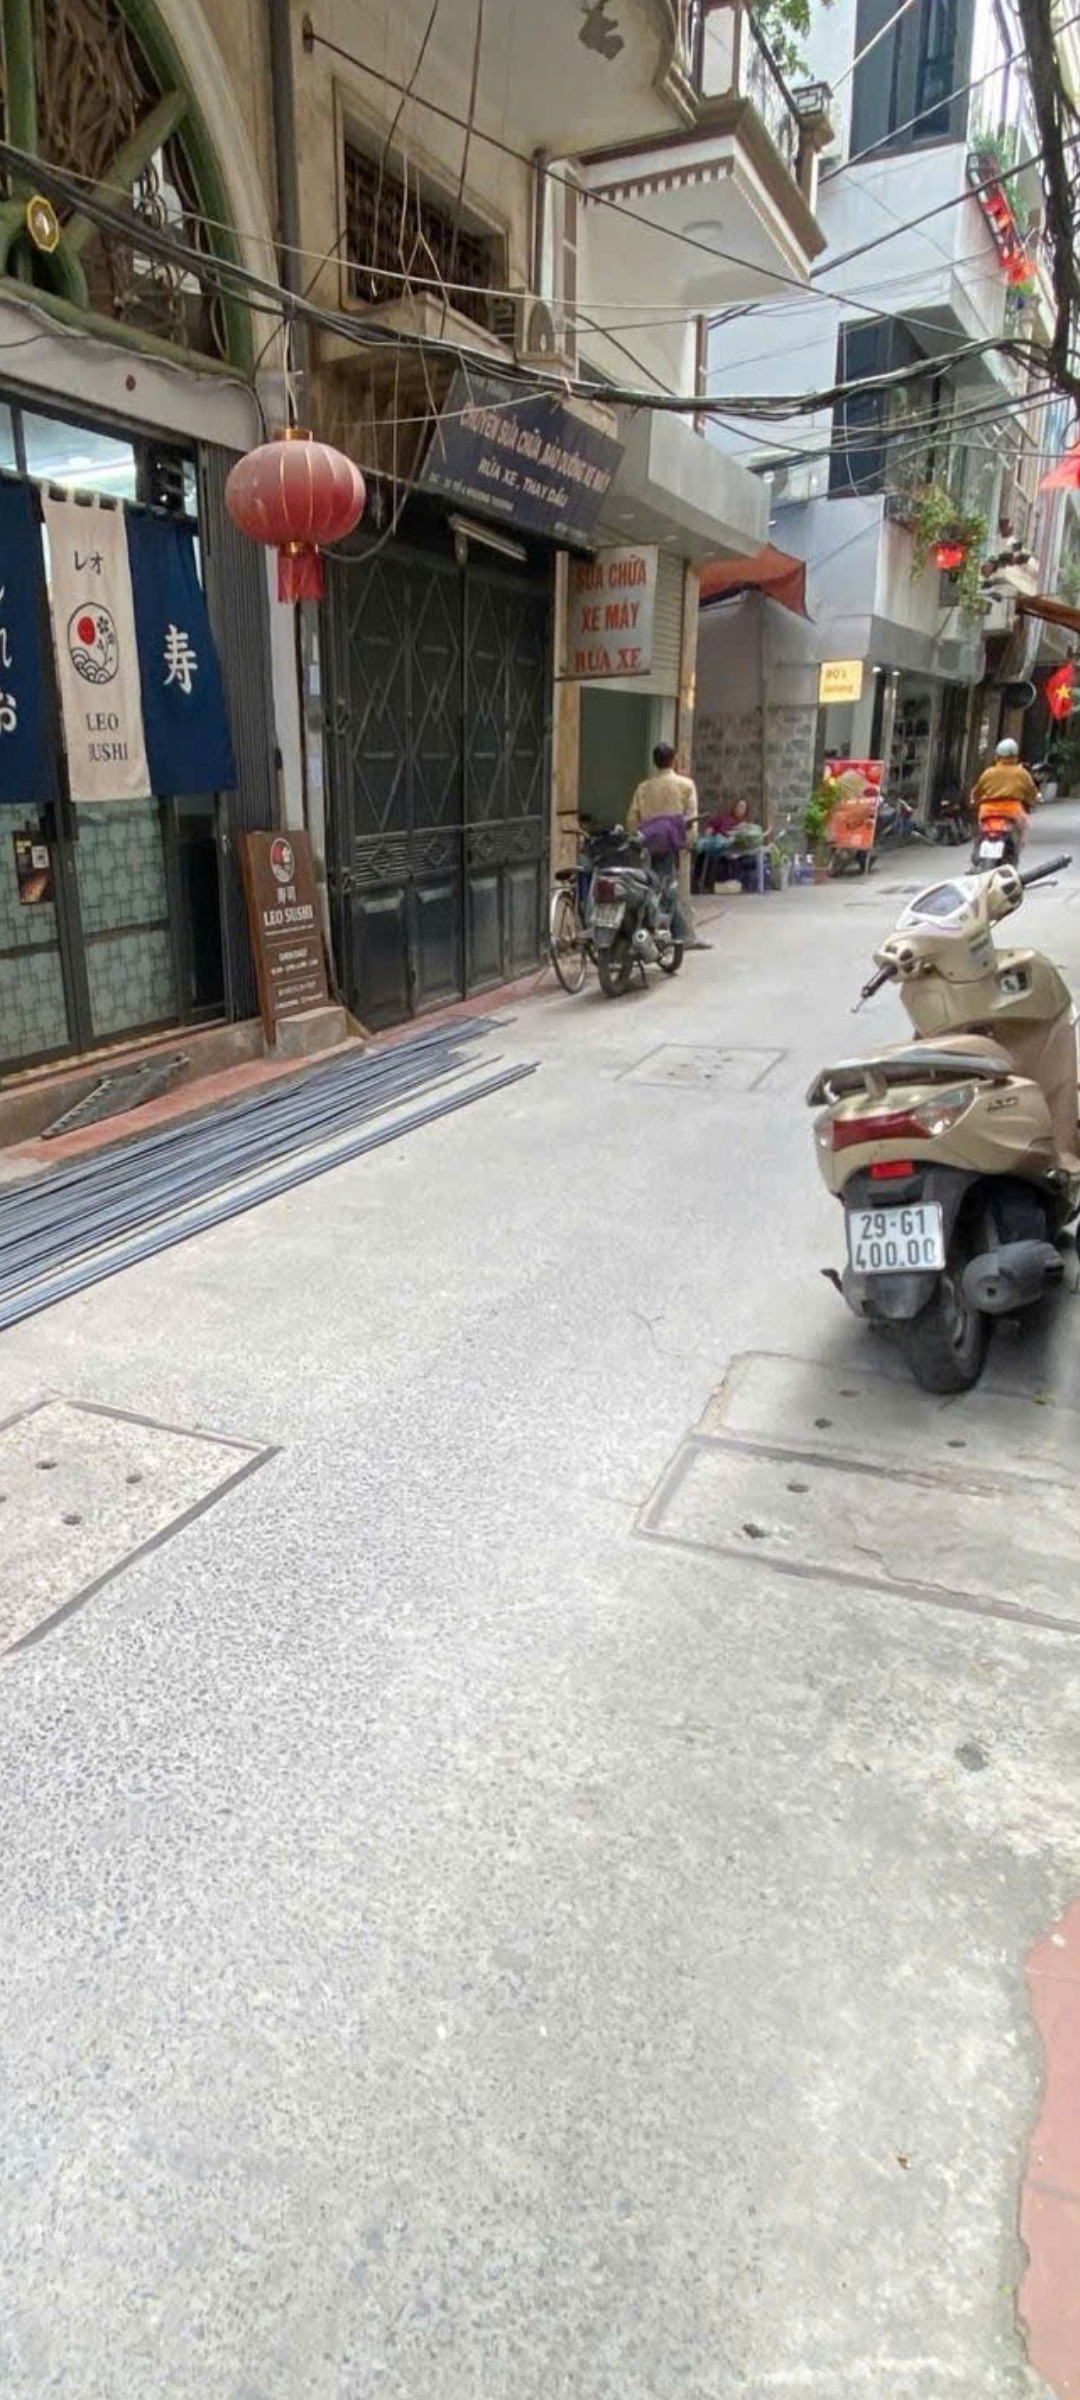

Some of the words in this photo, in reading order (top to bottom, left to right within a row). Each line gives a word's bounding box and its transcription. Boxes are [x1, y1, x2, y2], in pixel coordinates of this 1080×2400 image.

[523, 477, 549, 499] THAY
[73, 550, 104, 575] レオ
[581, 604, 600, 632] XE
[605, 597, 640, 631] MÁY
[163, 624, 198, 695] 寿
[616, 647, 641, 670] XE
[86, 712, 119, 731] LEO
[263, 910, 284, 926] LEO
[284, 904, 313, 923] SUSHI
[861, 1208, 926, 1240] 29-G1
[856, 1238, 935, 1269] 400.00
